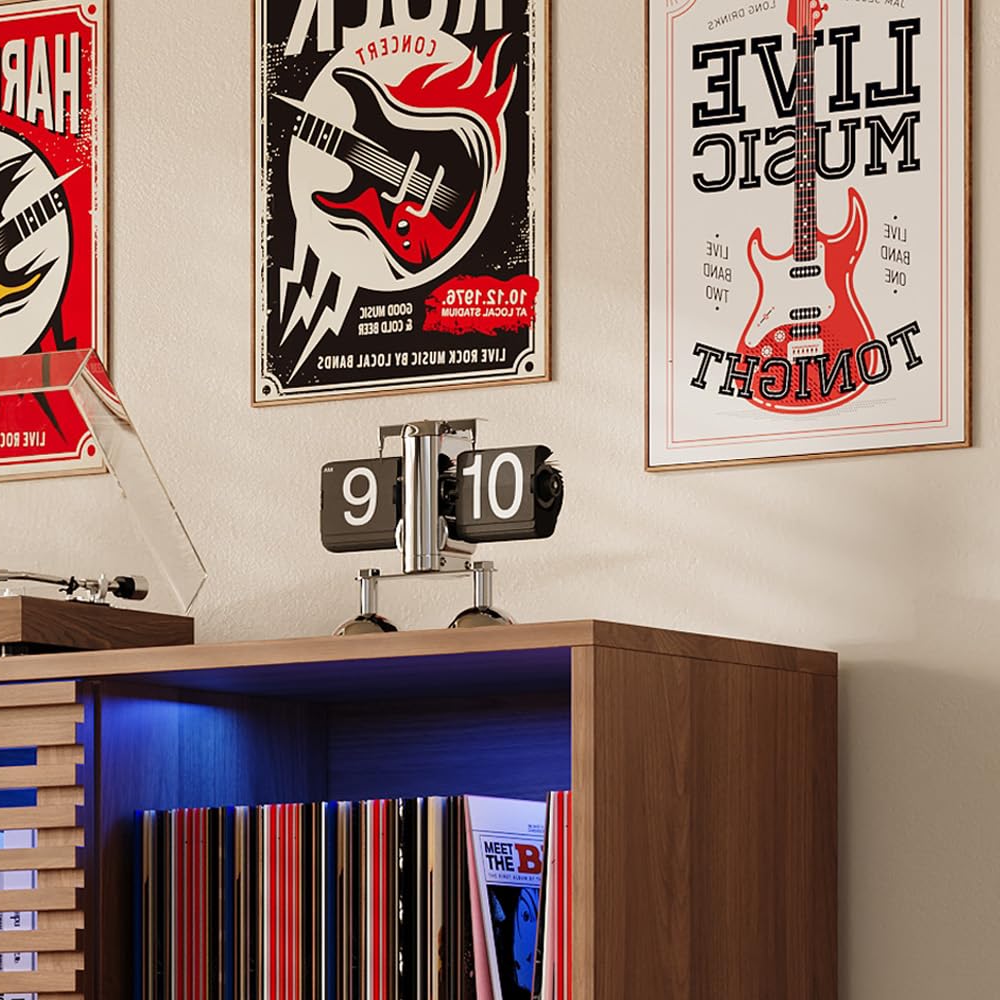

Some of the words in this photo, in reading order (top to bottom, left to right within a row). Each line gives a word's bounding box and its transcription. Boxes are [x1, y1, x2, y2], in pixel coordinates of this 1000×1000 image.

[342, 467, 378, 526] 9
[462, 452, 523, 520] 10
[484, 841, 513, 855] MEET
[485, 854, 515, 872] THE
[515, 843, 543, 874] B
